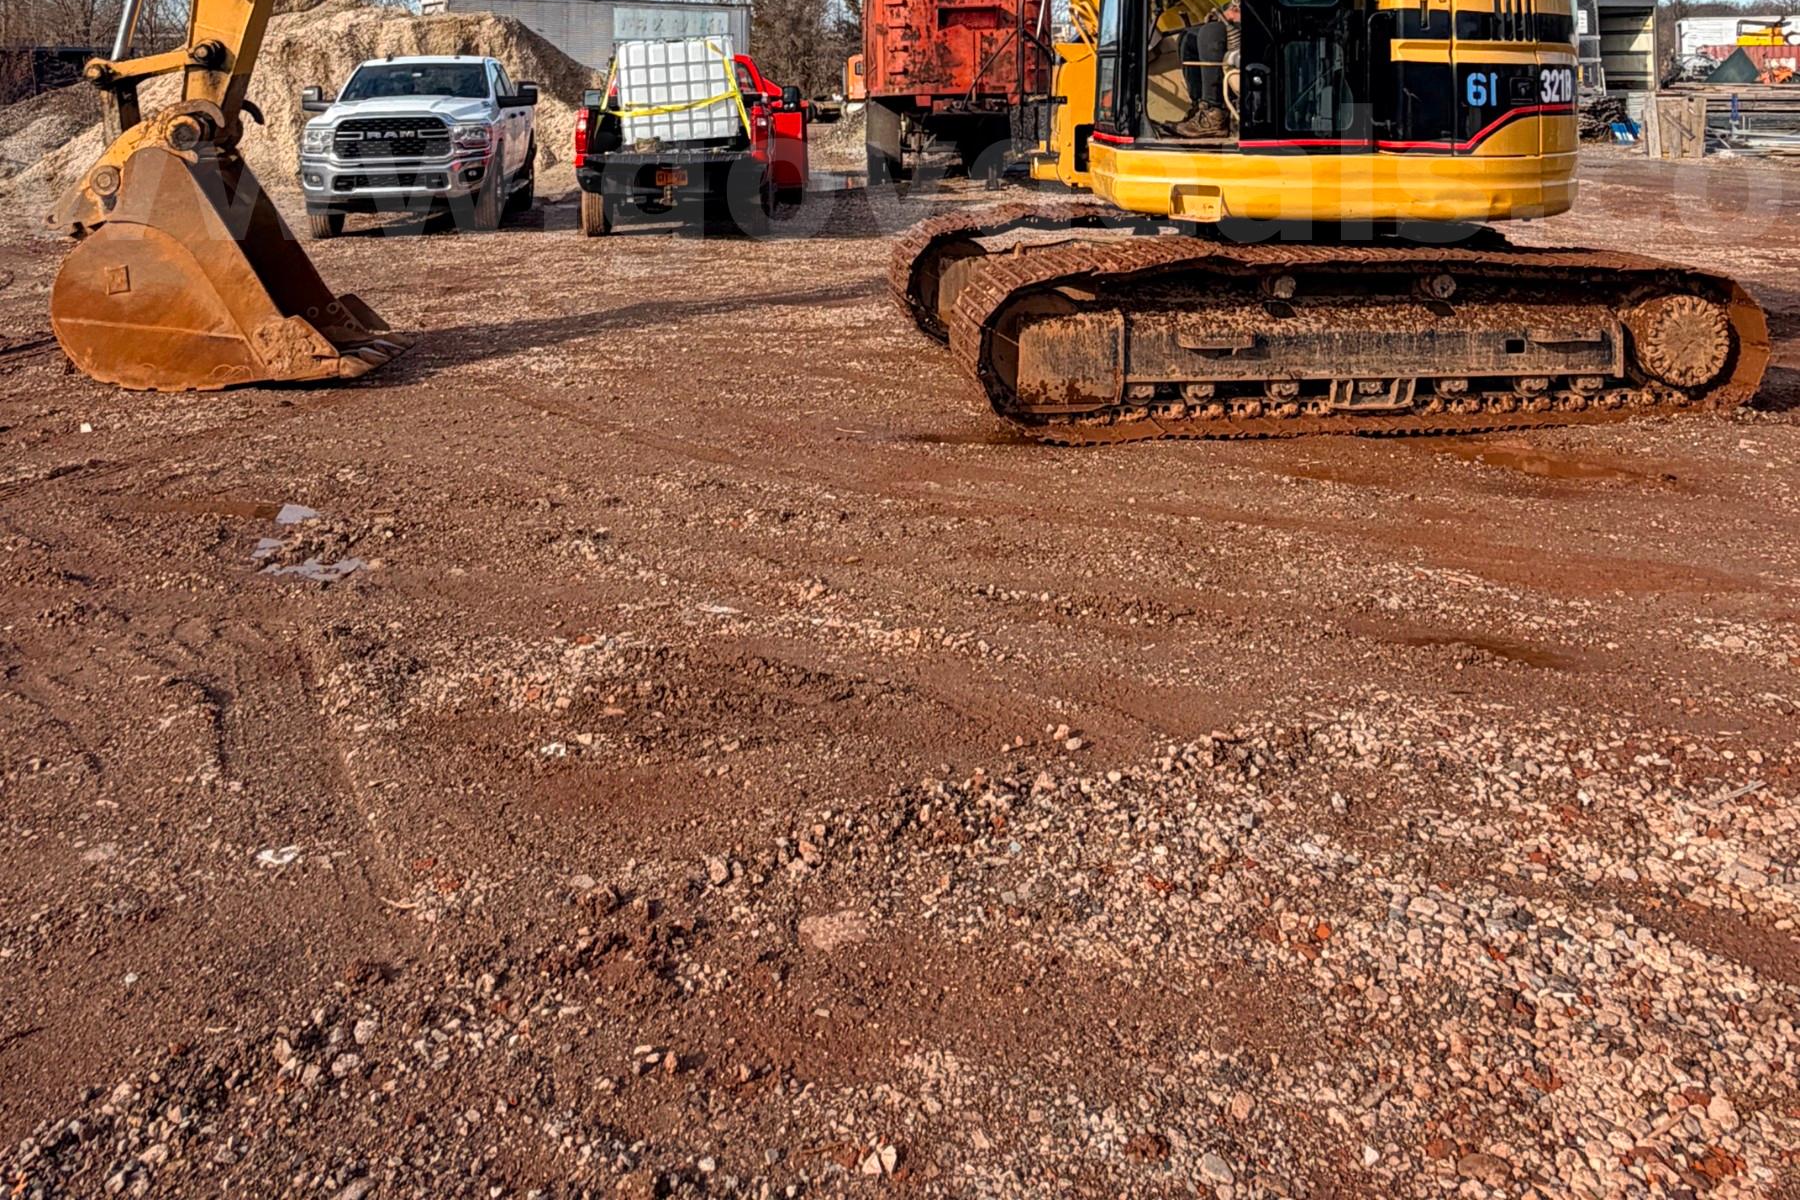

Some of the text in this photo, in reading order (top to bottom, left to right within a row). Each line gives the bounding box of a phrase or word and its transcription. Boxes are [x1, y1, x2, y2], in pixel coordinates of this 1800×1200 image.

[1466, 72, 1498, 106] 61
[1540, 69, 1572, 103] 321B
[366, 130, 416, 139] RAM
